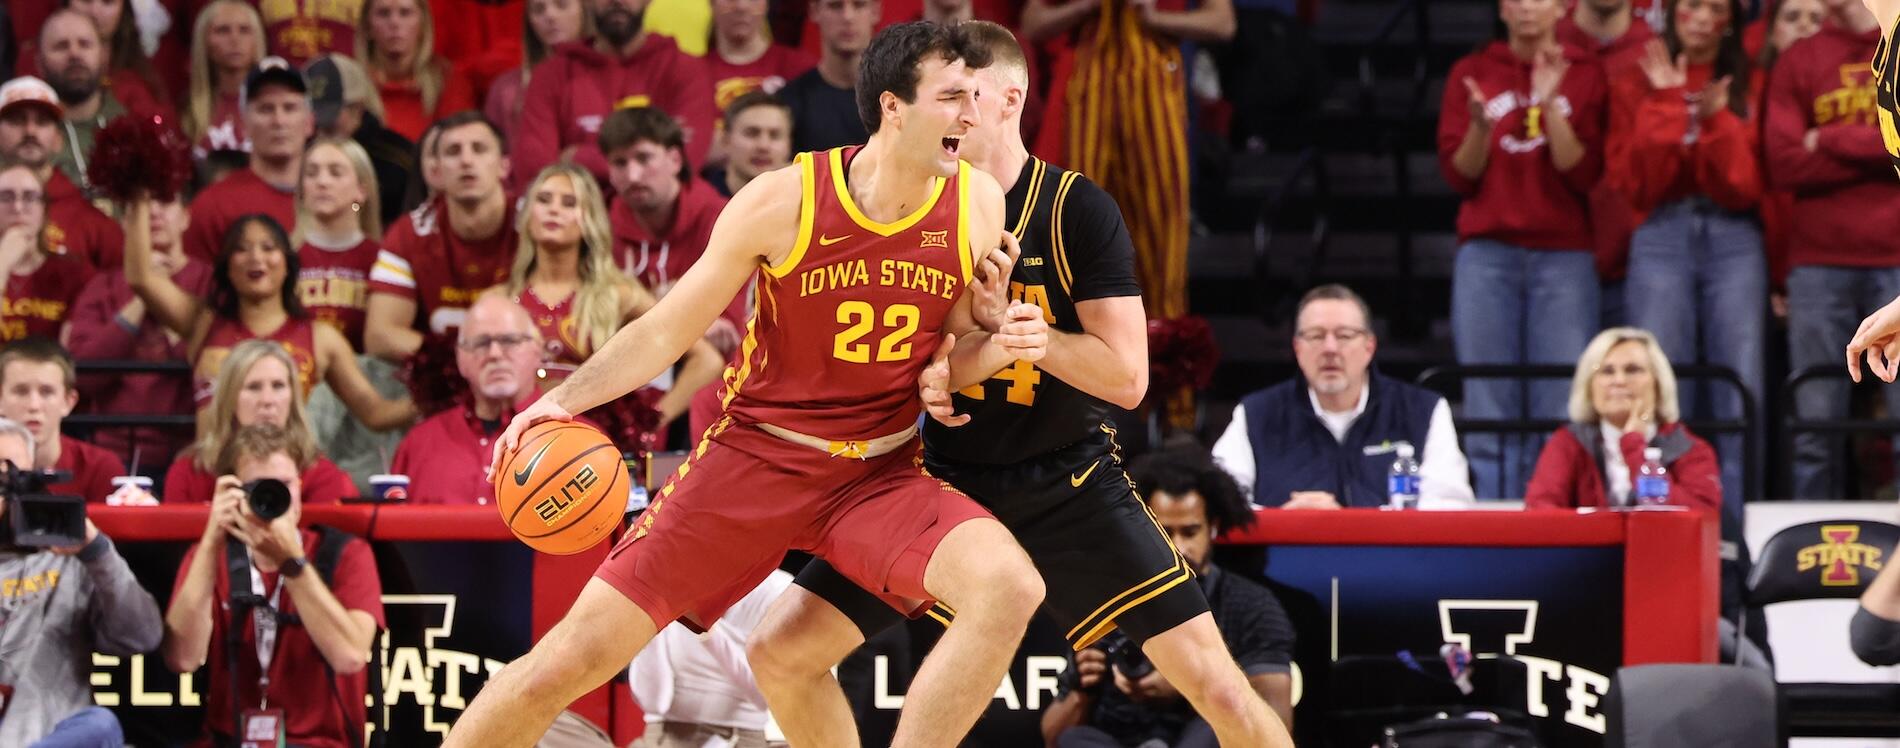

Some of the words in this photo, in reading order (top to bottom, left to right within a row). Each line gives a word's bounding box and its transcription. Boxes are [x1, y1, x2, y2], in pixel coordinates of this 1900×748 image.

[800, 259, 869, 297] IOWA
[880, 259, 957, 300] STATE
[833, 300, 921, 364] 22
[1796, 542, 1883, 573] STATE
